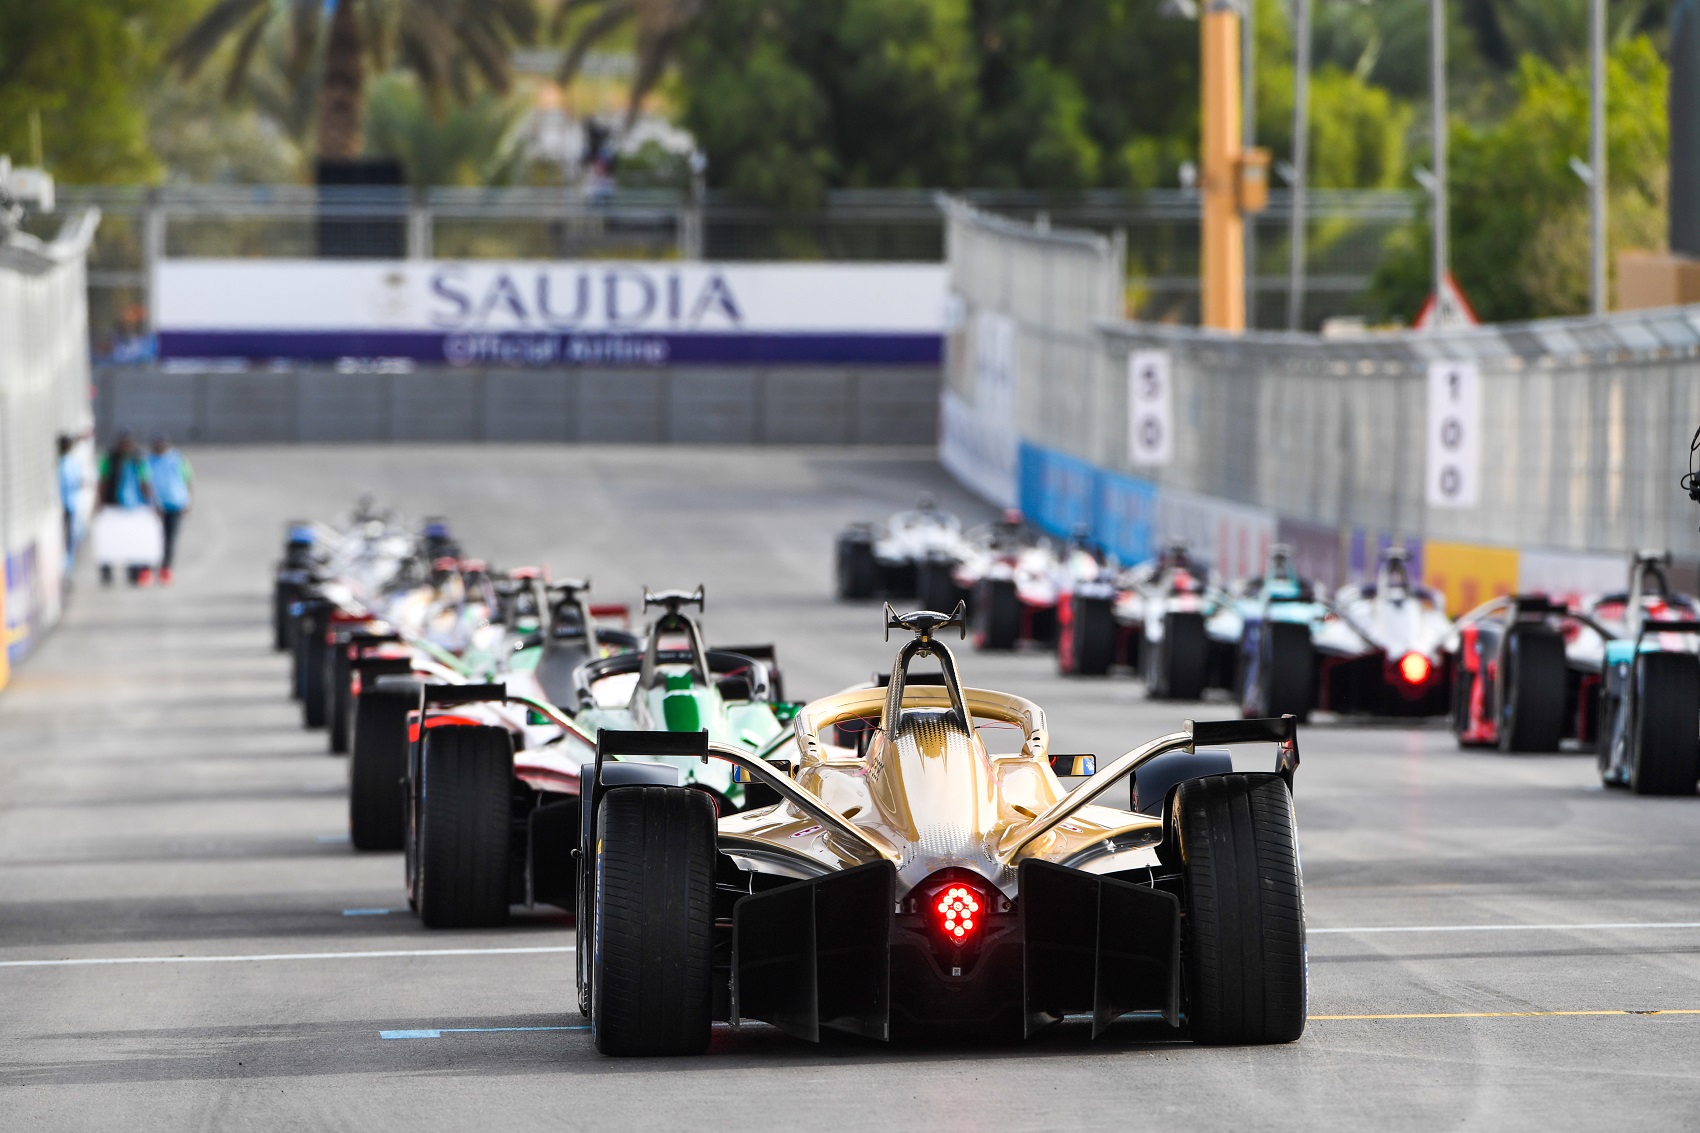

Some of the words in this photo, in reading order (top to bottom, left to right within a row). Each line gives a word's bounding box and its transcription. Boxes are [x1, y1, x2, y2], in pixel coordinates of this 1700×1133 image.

[430, 266, 743, 331] SAUDIA
[443, 334, 559, 362] Official
[567, 334, 668, 361] Airline
[1137, 361, 1163, 452] 50
[1439, 371, 1463, 498] 100
